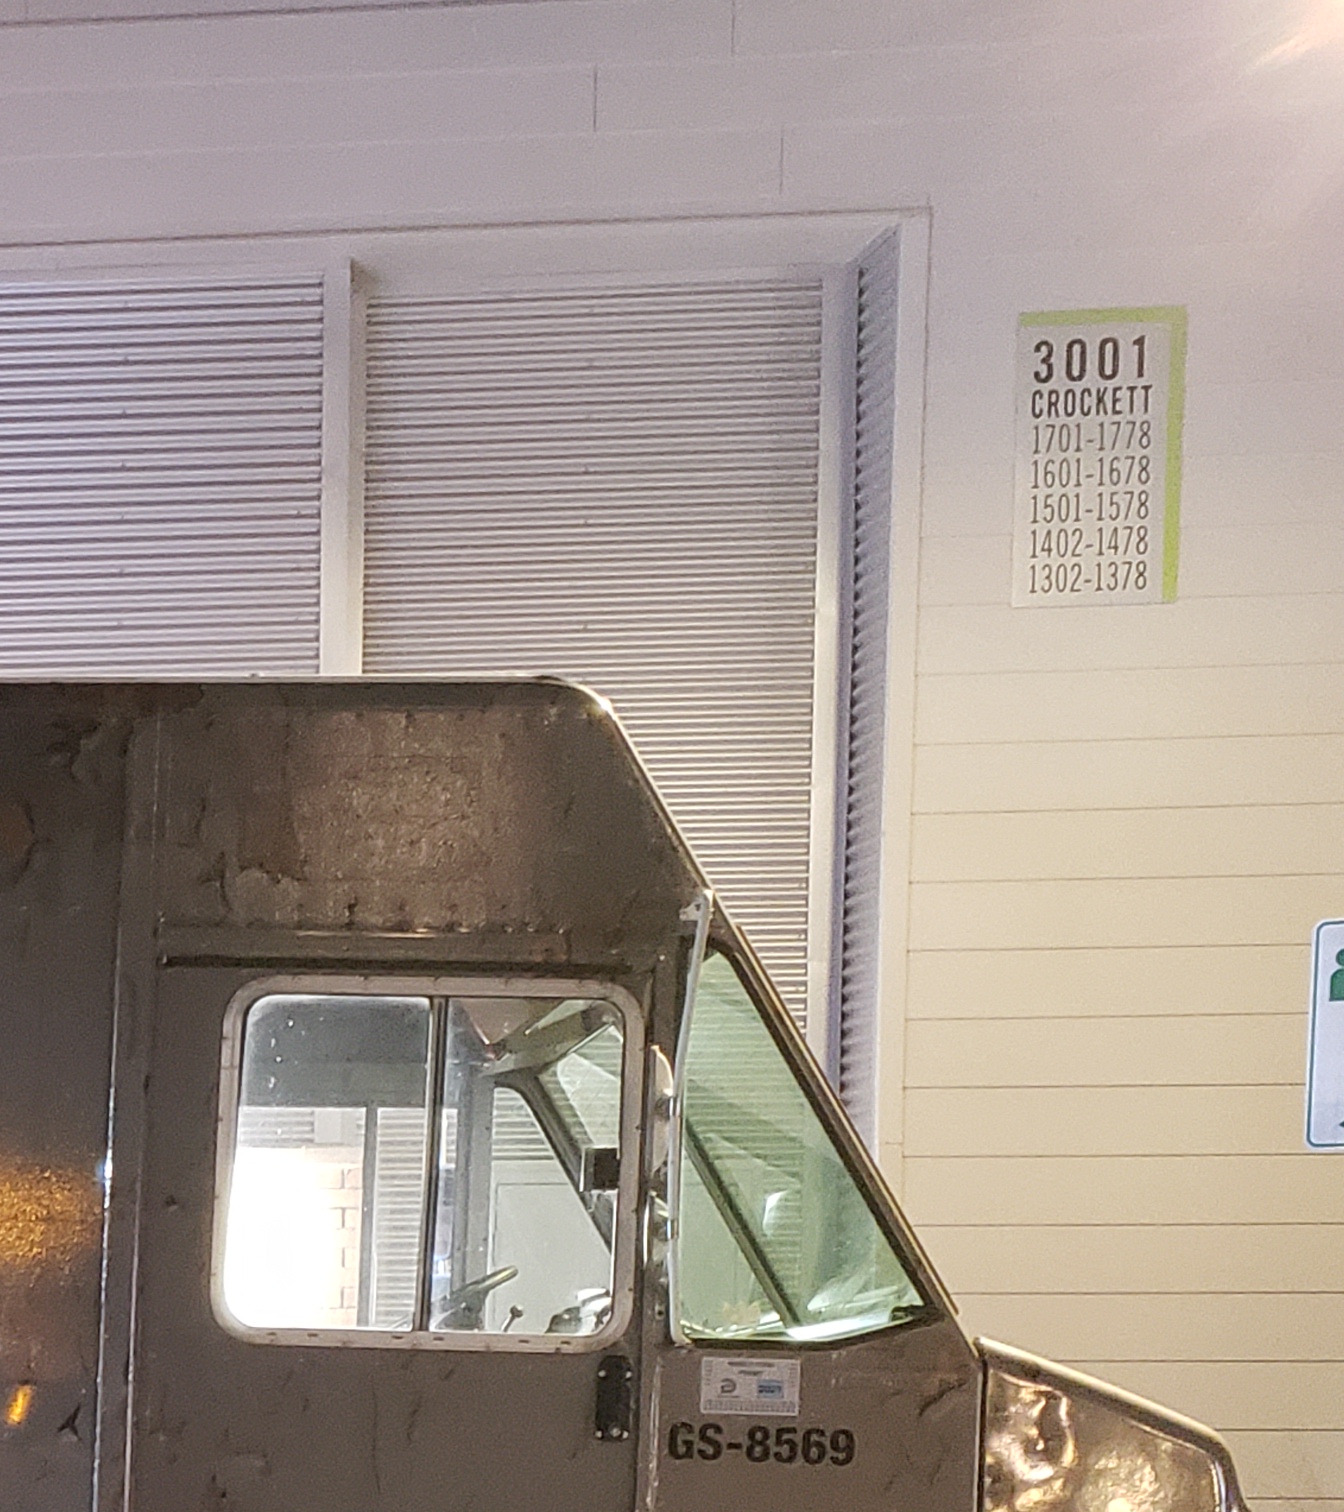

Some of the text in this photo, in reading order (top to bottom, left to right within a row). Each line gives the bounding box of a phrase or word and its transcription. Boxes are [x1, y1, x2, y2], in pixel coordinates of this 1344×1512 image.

[1032, 335, 1147, 384] 3001
[1031, 384, 1153, 419] CROCKETT
[1032, 420, 1152, 455] 1701-1778
[1031, 455, 1150, 489] 1601-1678
[1030, 490, 1149, 524] 1501-1578
[1029, 525, 1149, 559] 1402-1478
[1029, 560, 1148, 594] 1302-1378
[667, 1421, 856, 1467] GS-8569
